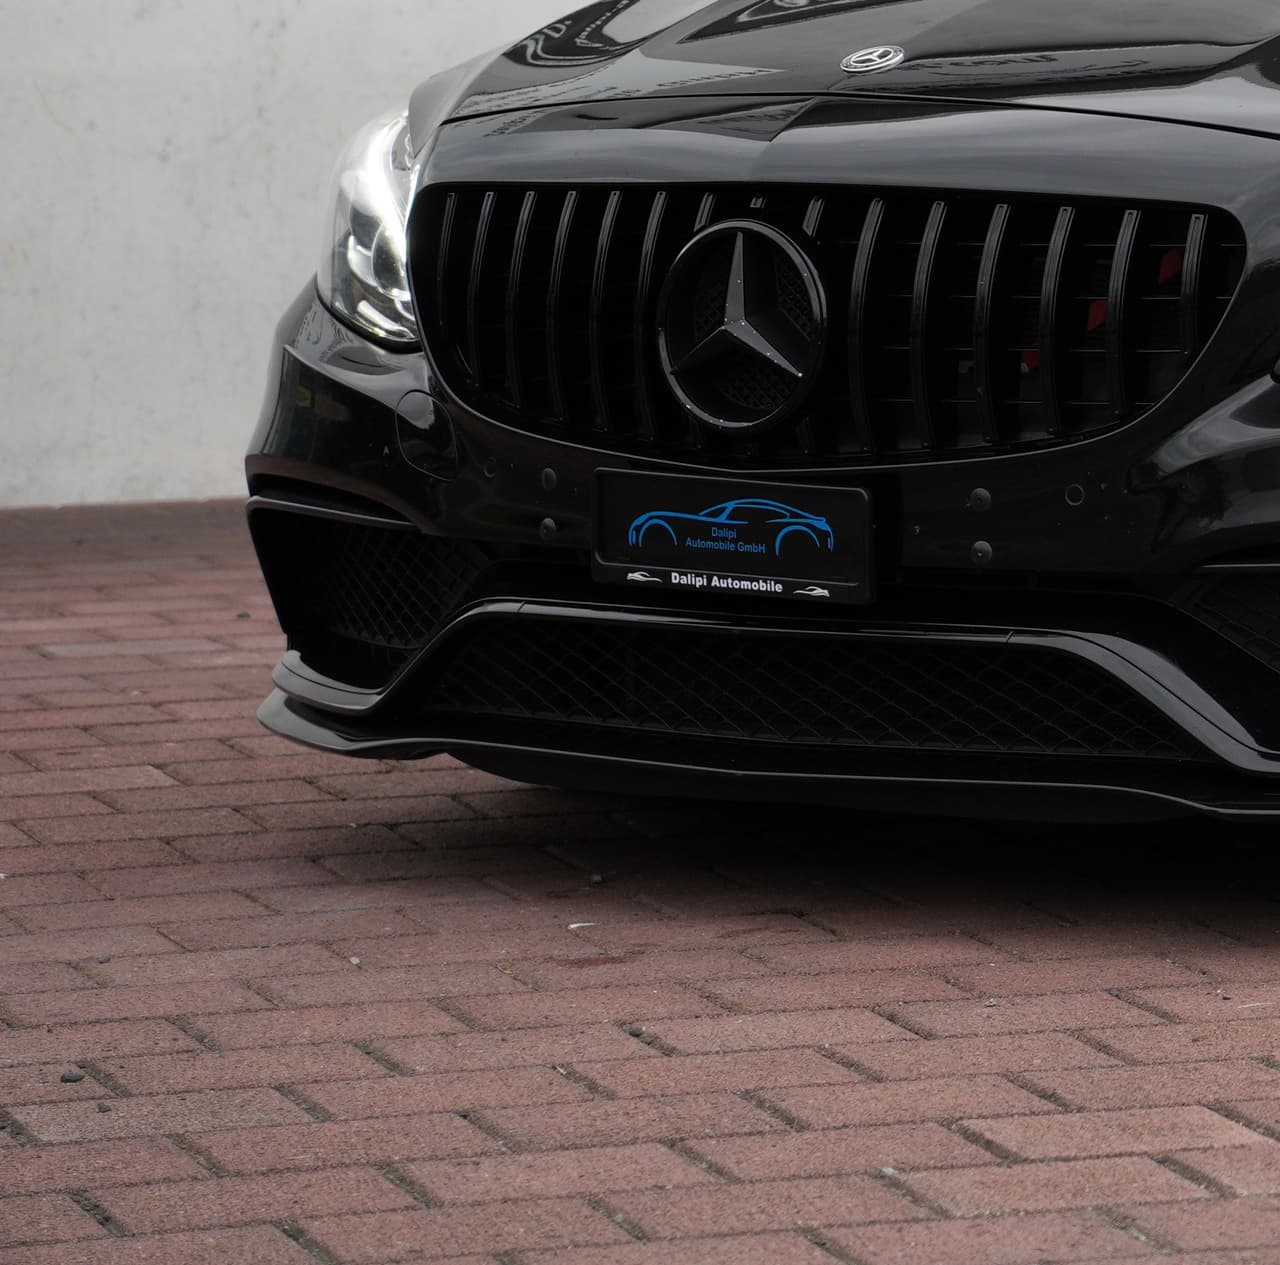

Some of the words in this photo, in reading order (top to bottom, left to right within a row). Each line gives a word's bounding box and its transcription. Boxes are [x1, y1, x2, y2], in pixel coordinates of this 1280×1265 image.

[711, 526, 737, 540] Dalipi
[685, 537, 735, 551] Automobile
[737, 542, 766, 554] GmbH
[671, 572, 708, 587] Dalipi
[711, 575, 783, 592] Automobile
